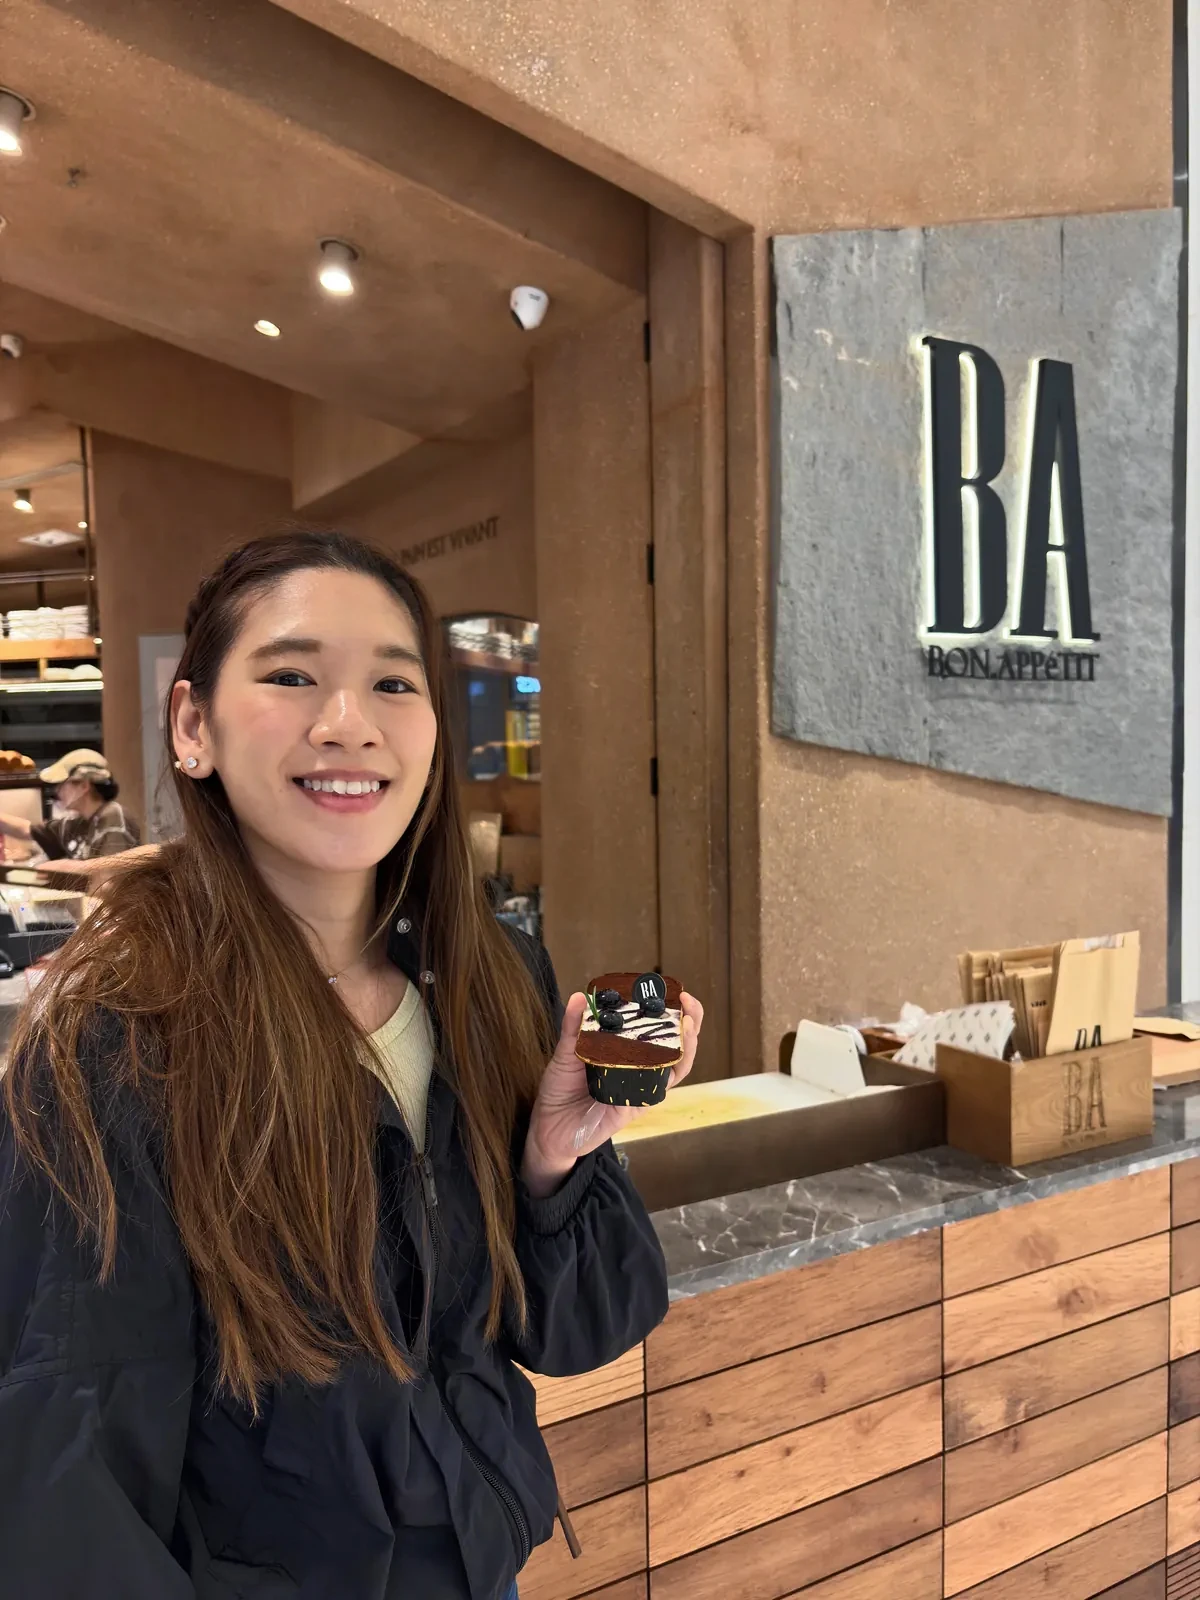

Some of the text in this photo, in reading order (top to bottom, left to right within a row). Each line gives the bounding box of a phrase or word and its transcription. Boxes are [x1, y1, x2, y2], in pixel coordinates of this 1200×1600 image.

[921, 336, 1100, 641] BA
[640, 979, 658, 999] BA
[1062, 1056, 1108, 1136] BA
